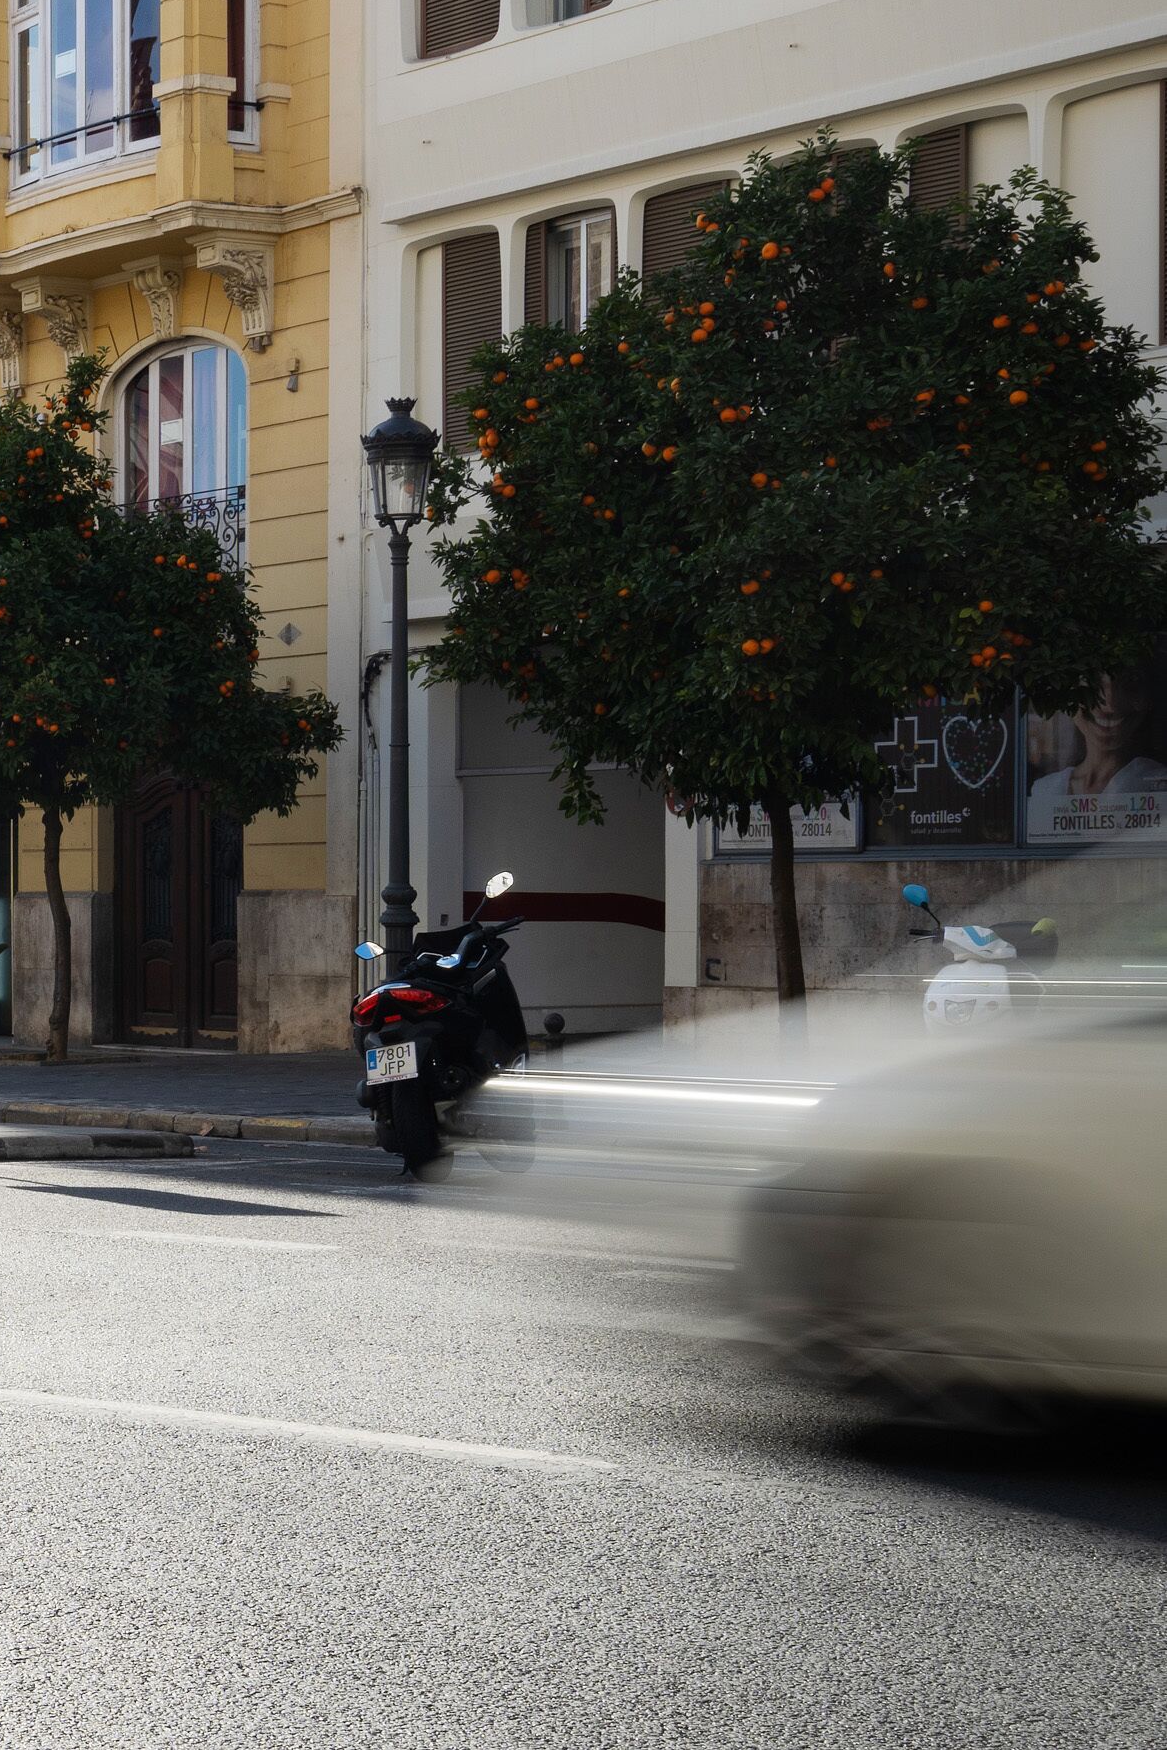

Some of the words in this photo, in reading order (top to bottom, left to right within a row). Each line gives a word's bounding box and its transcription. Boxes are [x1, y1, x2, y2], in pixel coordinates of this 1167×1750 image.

[1070, 797, 1098, 813] SMS
[910, 809, 962, 825] fontilles
[1053, 814, 1115, 831] FONTILLES
[1125, 813, 1161, 829] 28014
[801, 823, 832, 837] 28014
[377, 1044, 411, 1063] 7801
[380, 1060, 406, 1076] JFP
